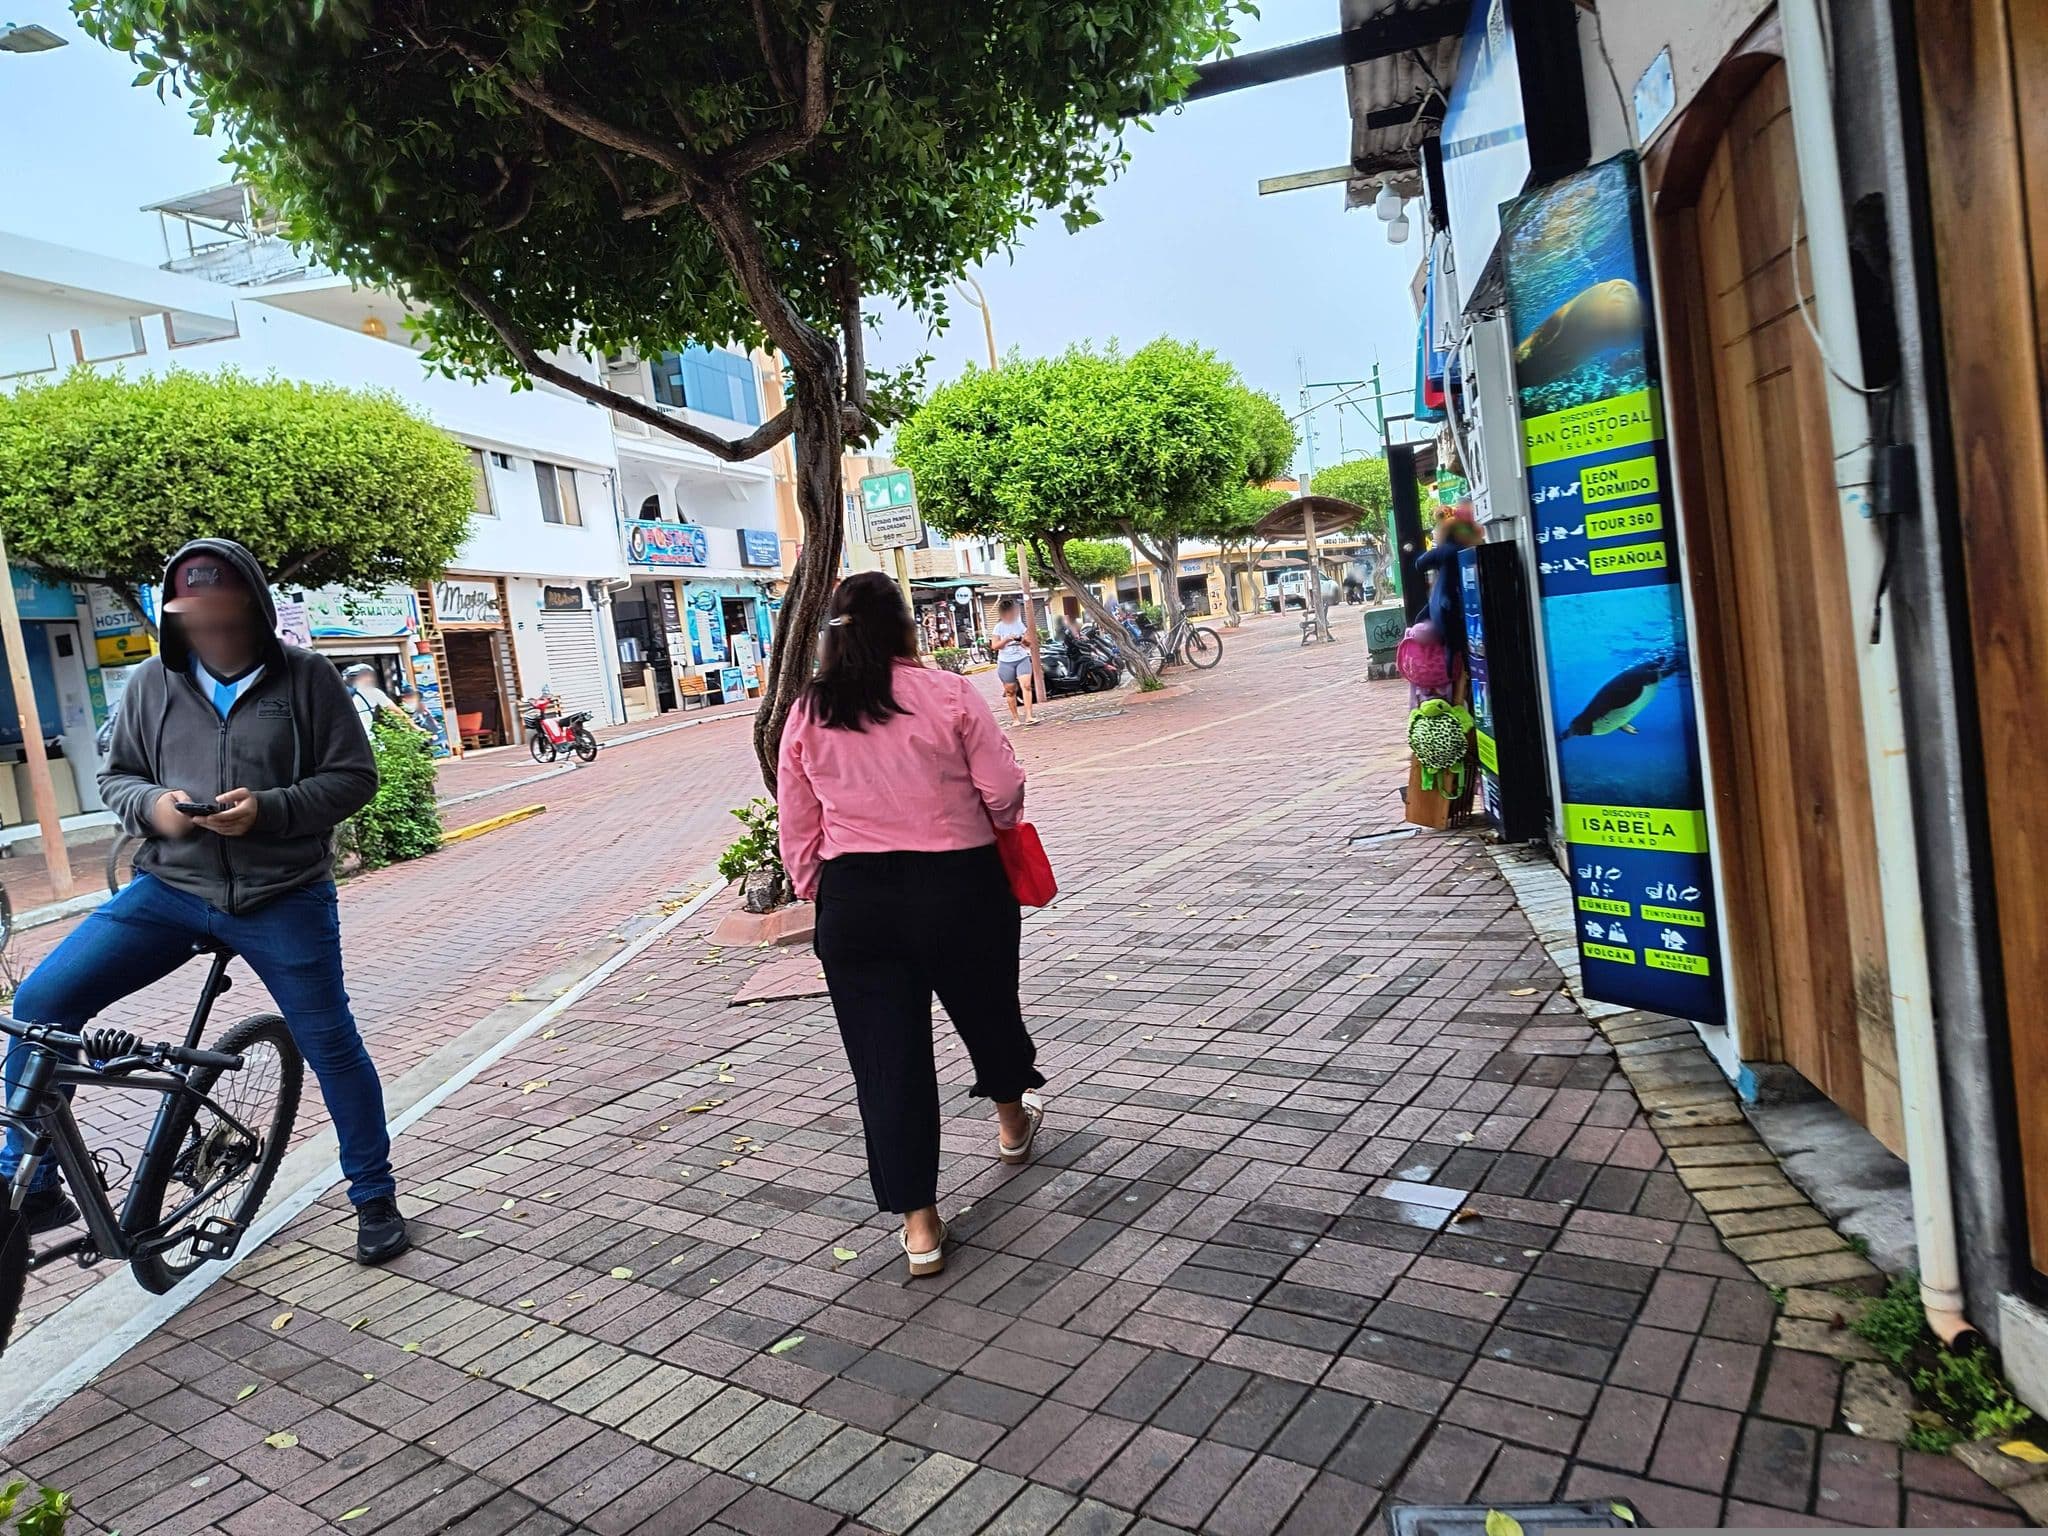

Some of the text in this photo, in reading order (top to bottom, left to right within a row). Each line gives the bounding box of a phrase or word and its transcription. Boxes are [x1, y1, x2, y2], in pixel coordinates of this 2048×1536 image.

[1560, 407, 1608, 424] DISCOVER
[1526, 410, 1652, 448] SAN CRISTOBAL
[1559, 434, 1614, 451] ISLAND
[1587, 478, 1650, 498] DORMIDO
[1591, 512, 1654, 532] TOUR 360
[1594, 550, 1663, 568] ESPAÑOLA
[1601, 809, 1650, 819] DISCOVER
[1582, 817, 1676, 837] ISABELA
[1602, 835, 1657, 846] ISLAND
